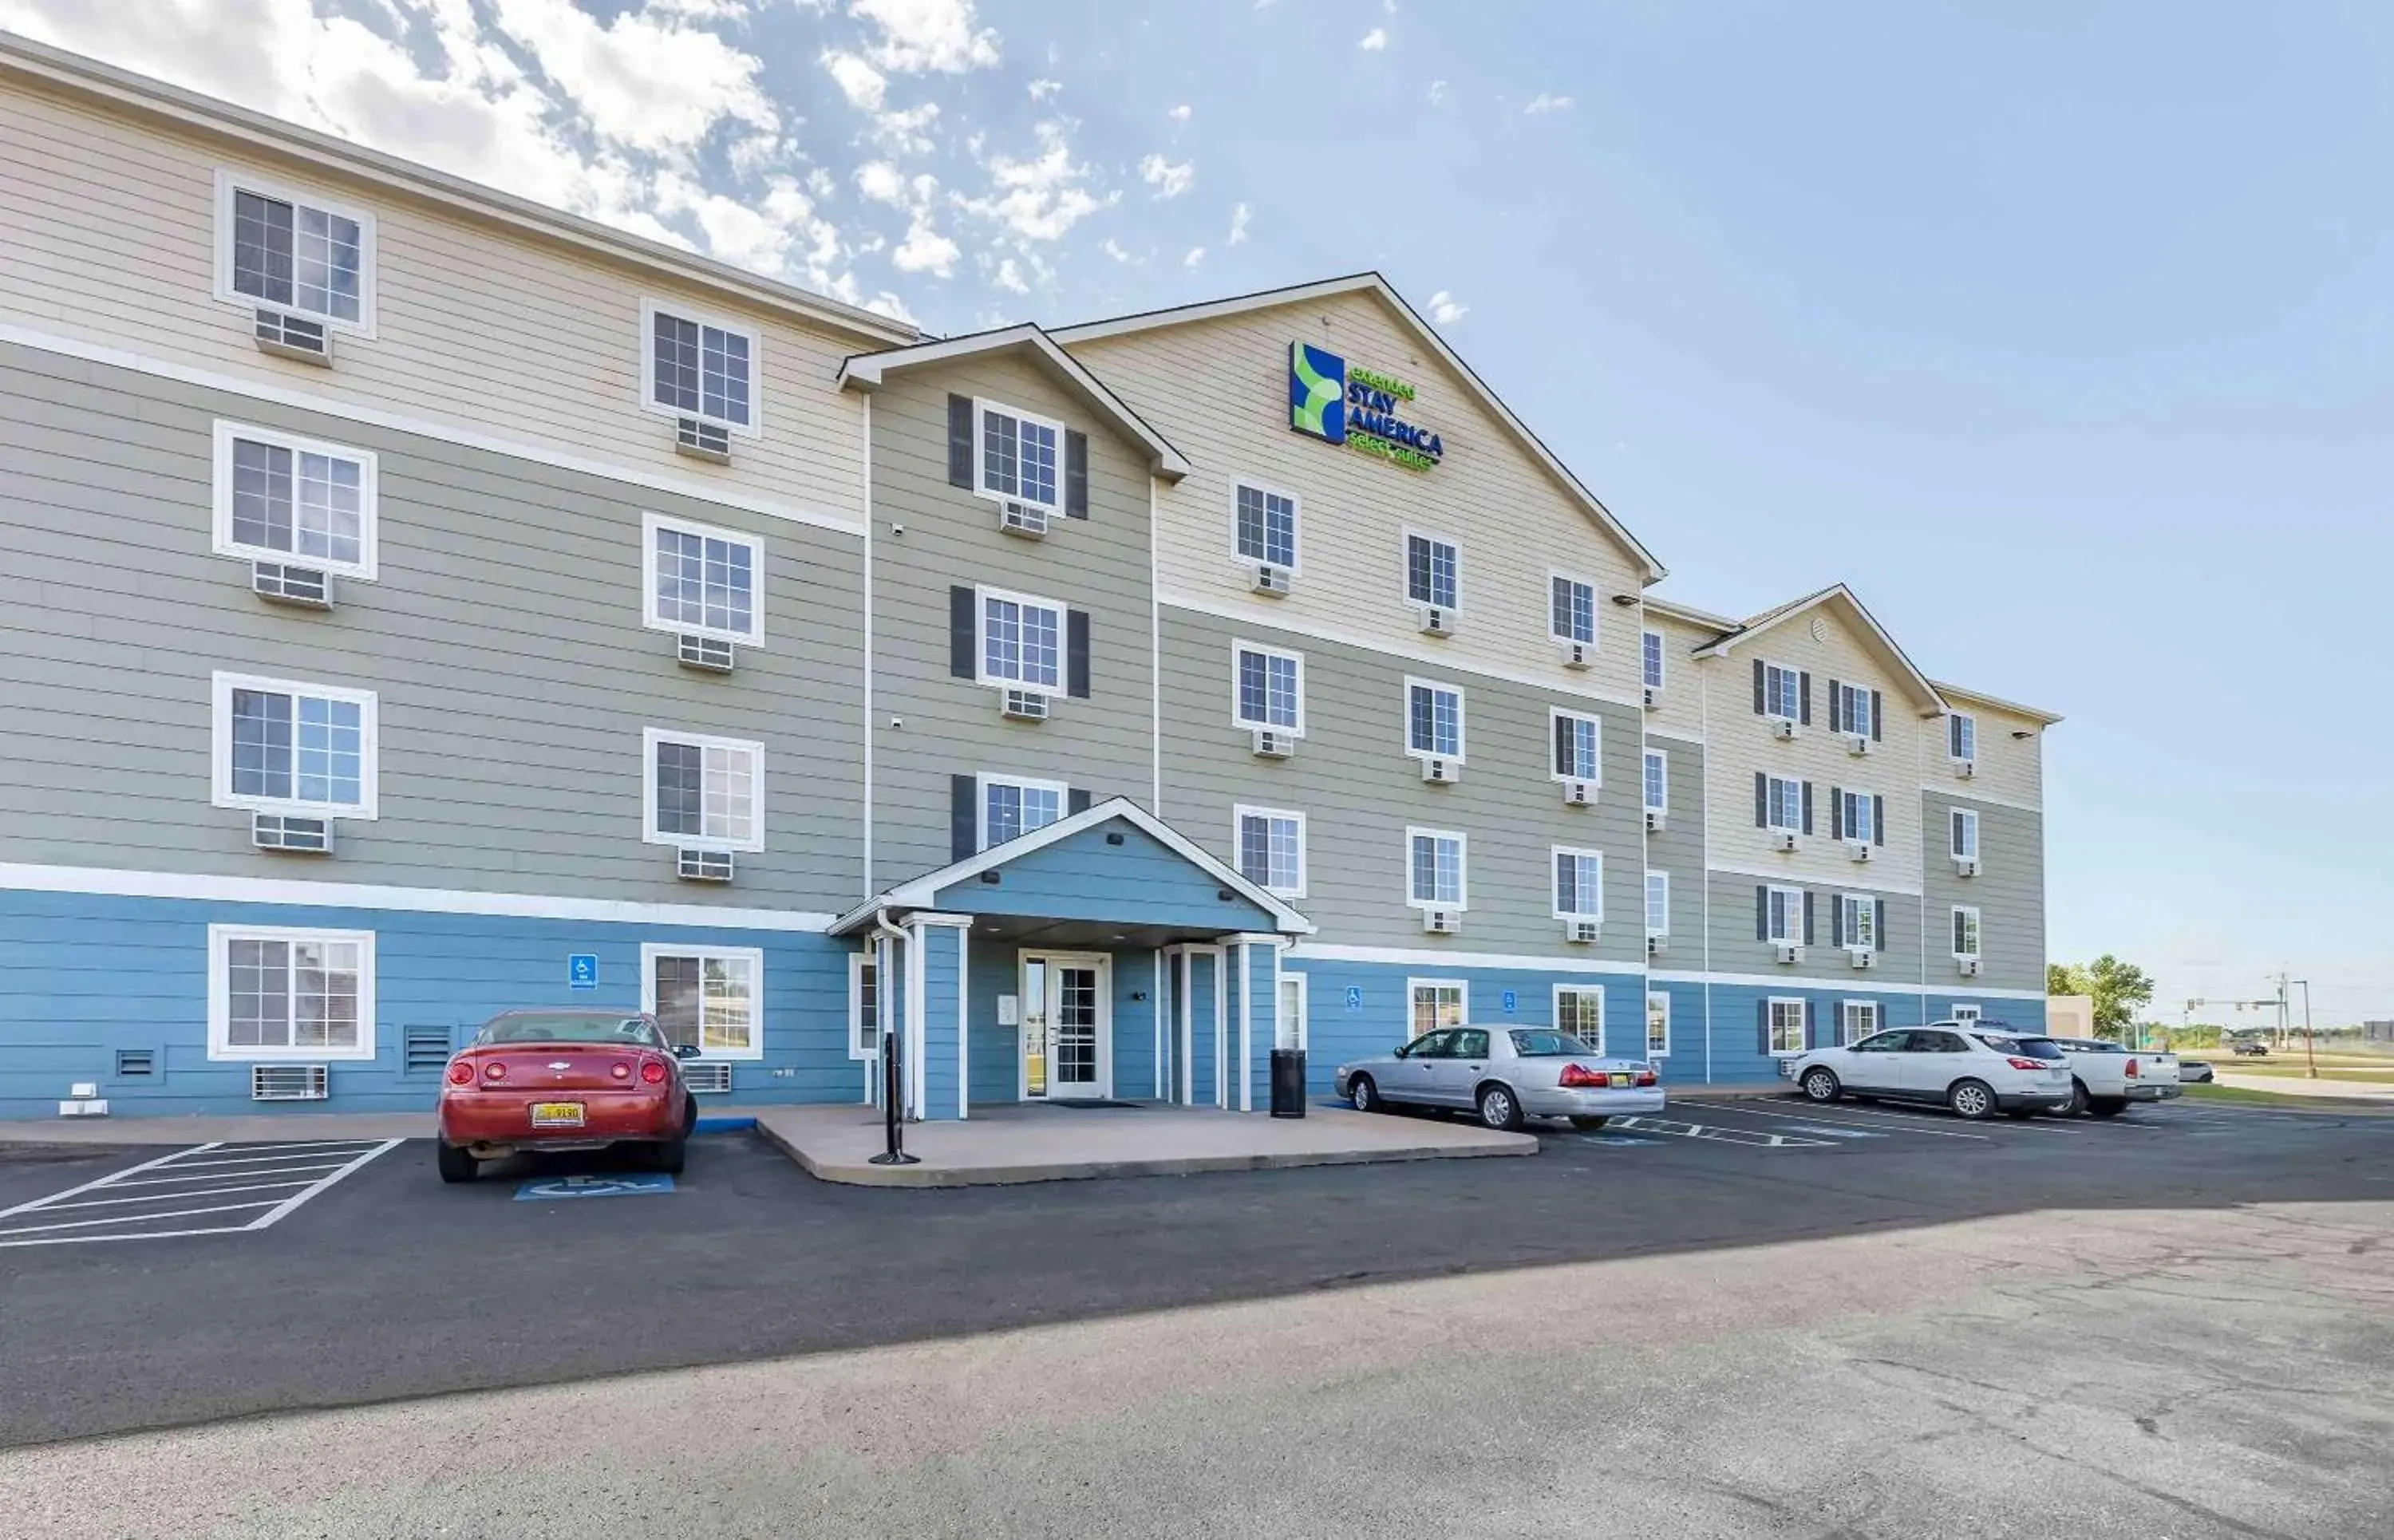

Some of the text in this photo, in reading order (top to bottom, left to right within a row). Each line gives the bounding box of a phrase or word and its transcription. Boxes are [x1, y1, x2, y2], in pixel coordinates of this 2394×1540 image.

[1348, 382, 1397, 415] STAY
[1348, 406, 1444, 456] AMERICA
[1349, 432, 1391, 452] select
